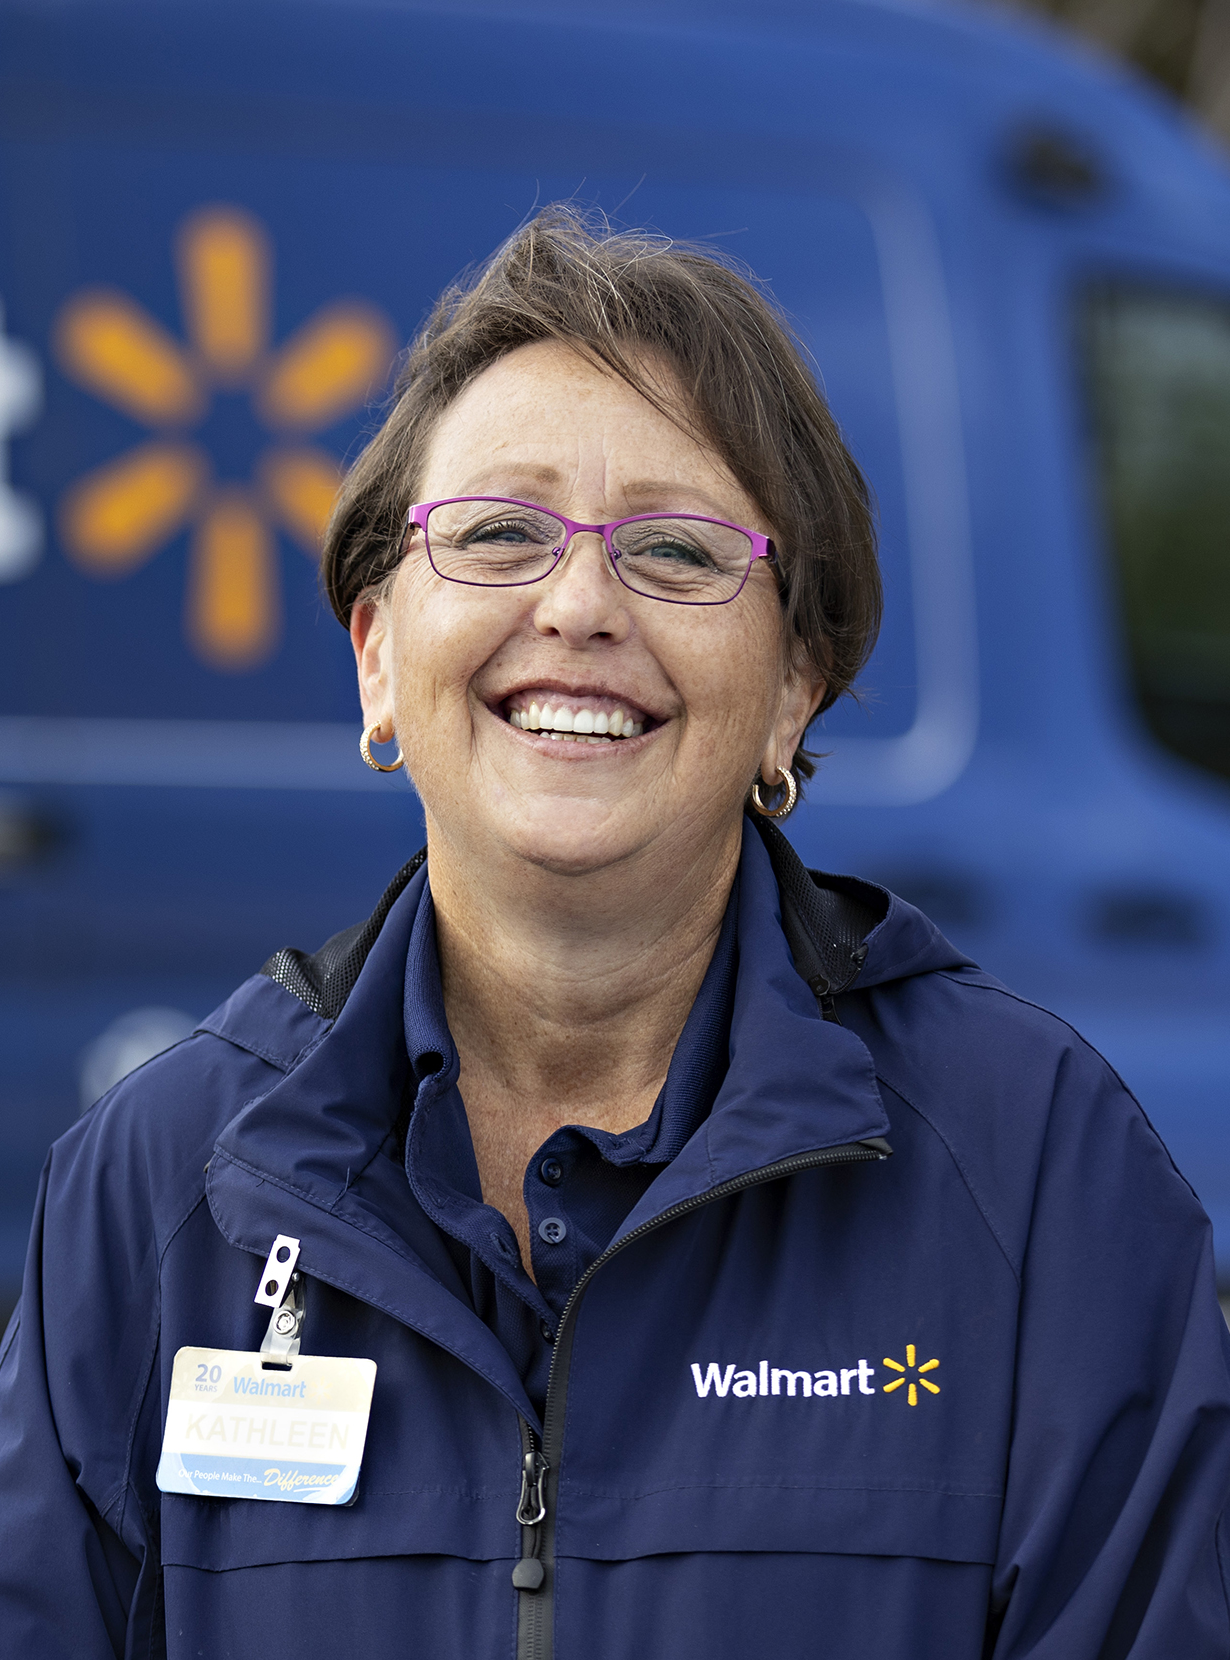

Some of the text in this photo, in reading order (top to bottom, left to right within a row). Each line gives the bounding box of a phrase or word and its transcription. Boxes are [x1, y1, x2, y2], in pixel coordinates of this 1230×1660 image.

[195, 1364, 222, 1384] 20
[691, 1359, 875, 1398] Walmart
[194, 1384, 218, 1393] YEARS
[233, 1376, 307, 1399] Walmart
[184, 1413, 349, 1450] KATHLEEN
[178, 1468, 192, 1479] Our
[194, 1469, 220, 1481] People
[221, 1471, 242, 1482] Make
[264, 1468, 340, 1492] Difference
